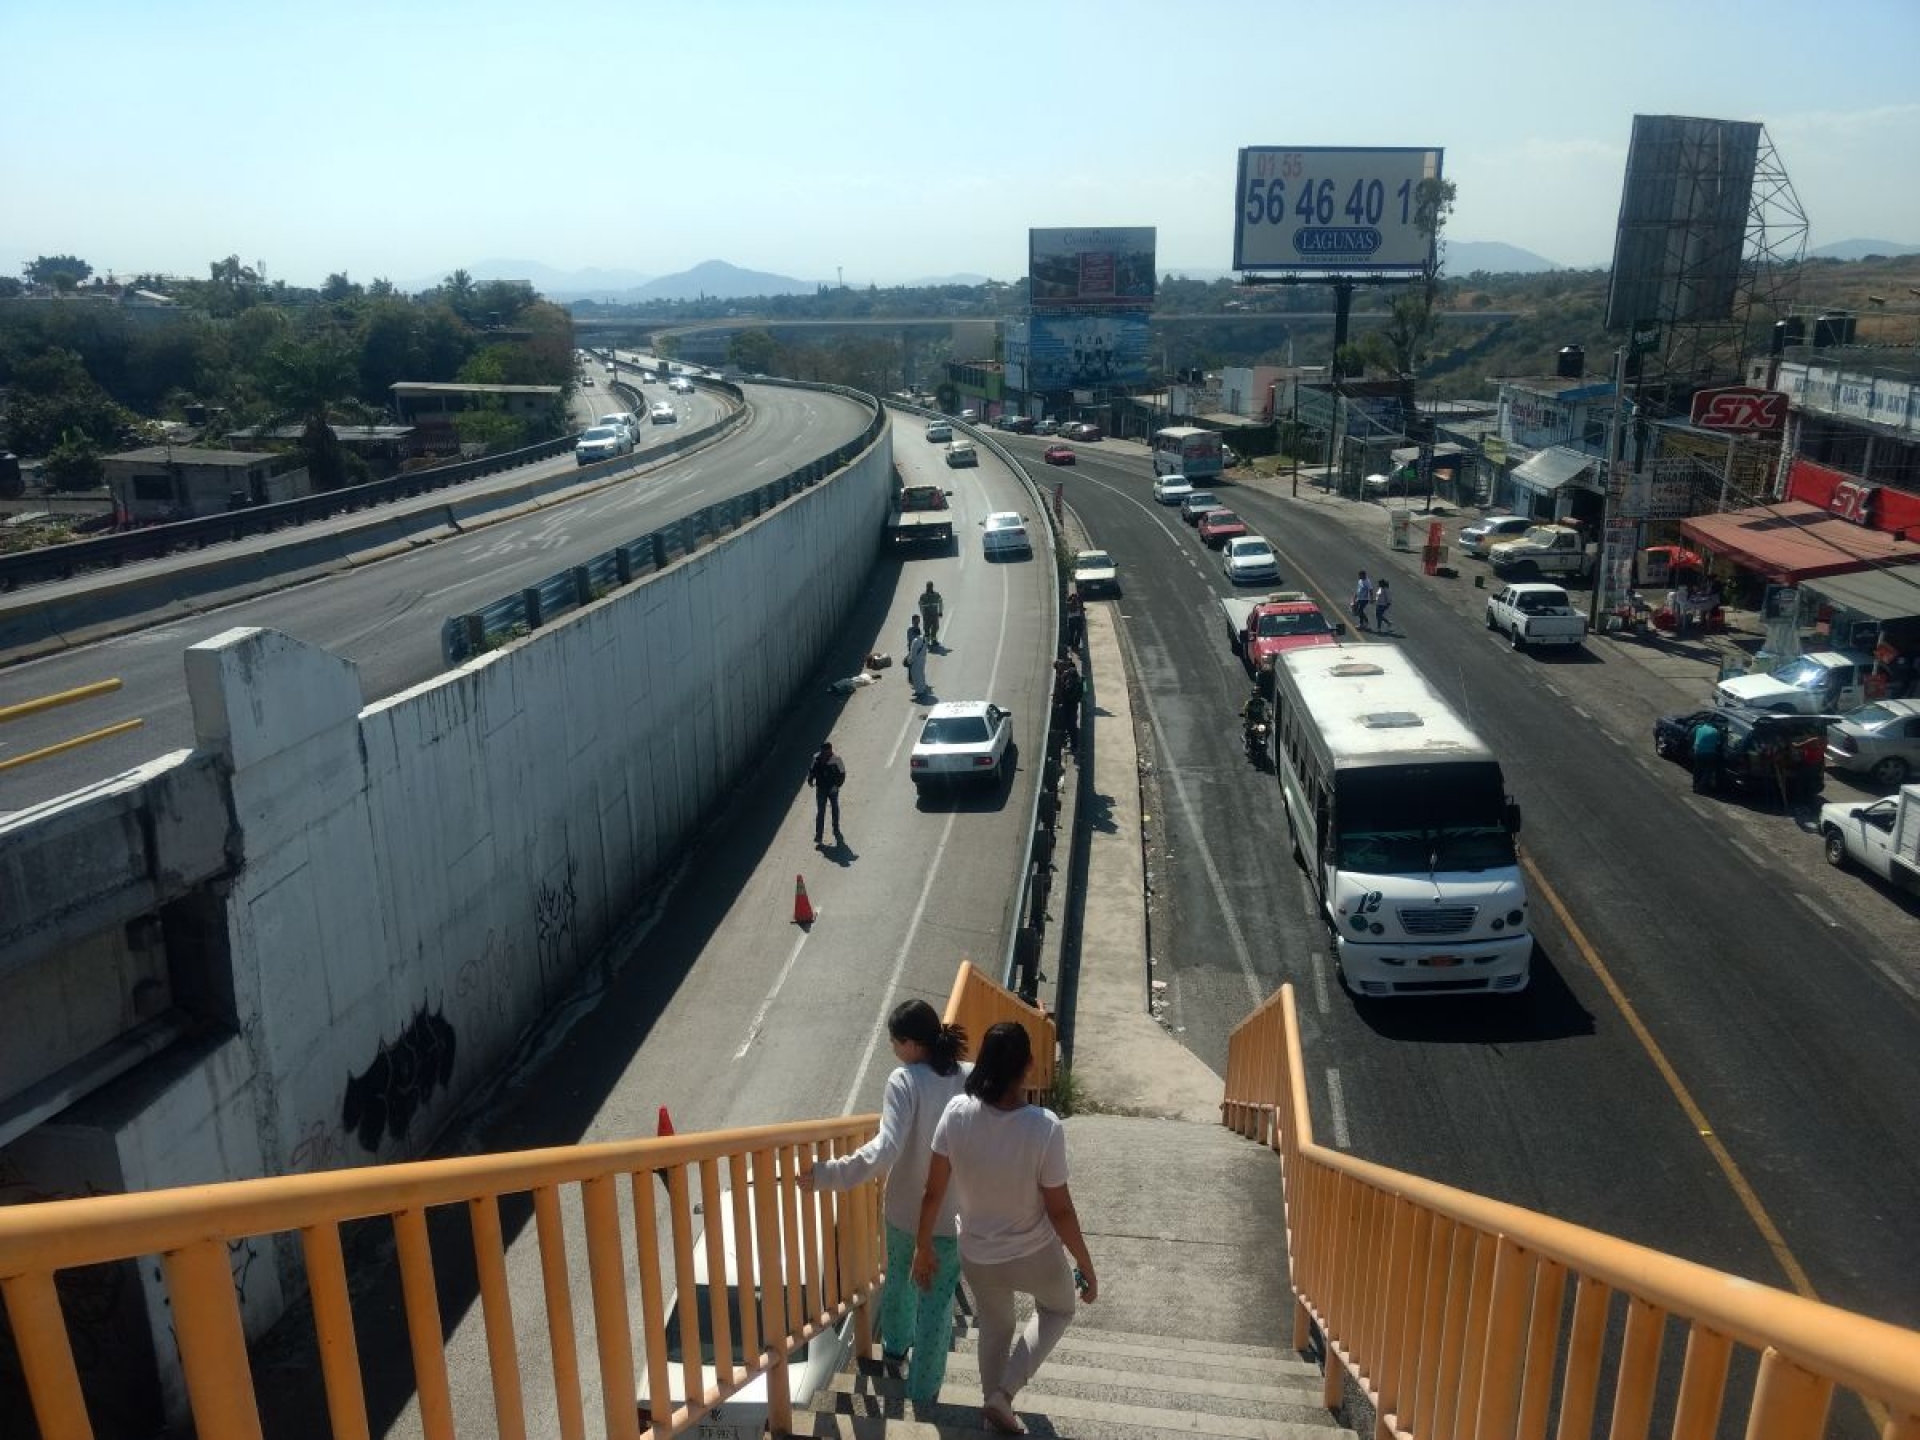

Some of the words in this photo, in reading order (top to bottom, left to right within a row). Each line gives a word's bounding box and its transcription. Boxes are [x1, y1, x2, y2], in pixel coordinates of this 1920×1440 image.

[1257, 153, 1275, 178] 01
[1282, 153, 1303, 178] 55
[1247, 179, 1286, 225] 56
[1296, 179, 1335, 225] 46
[1345, 179, 1384, 225] 40
[1302, 231, 1374, 250] LAGUNAS
[1354, 891, 1382, 914] 12
